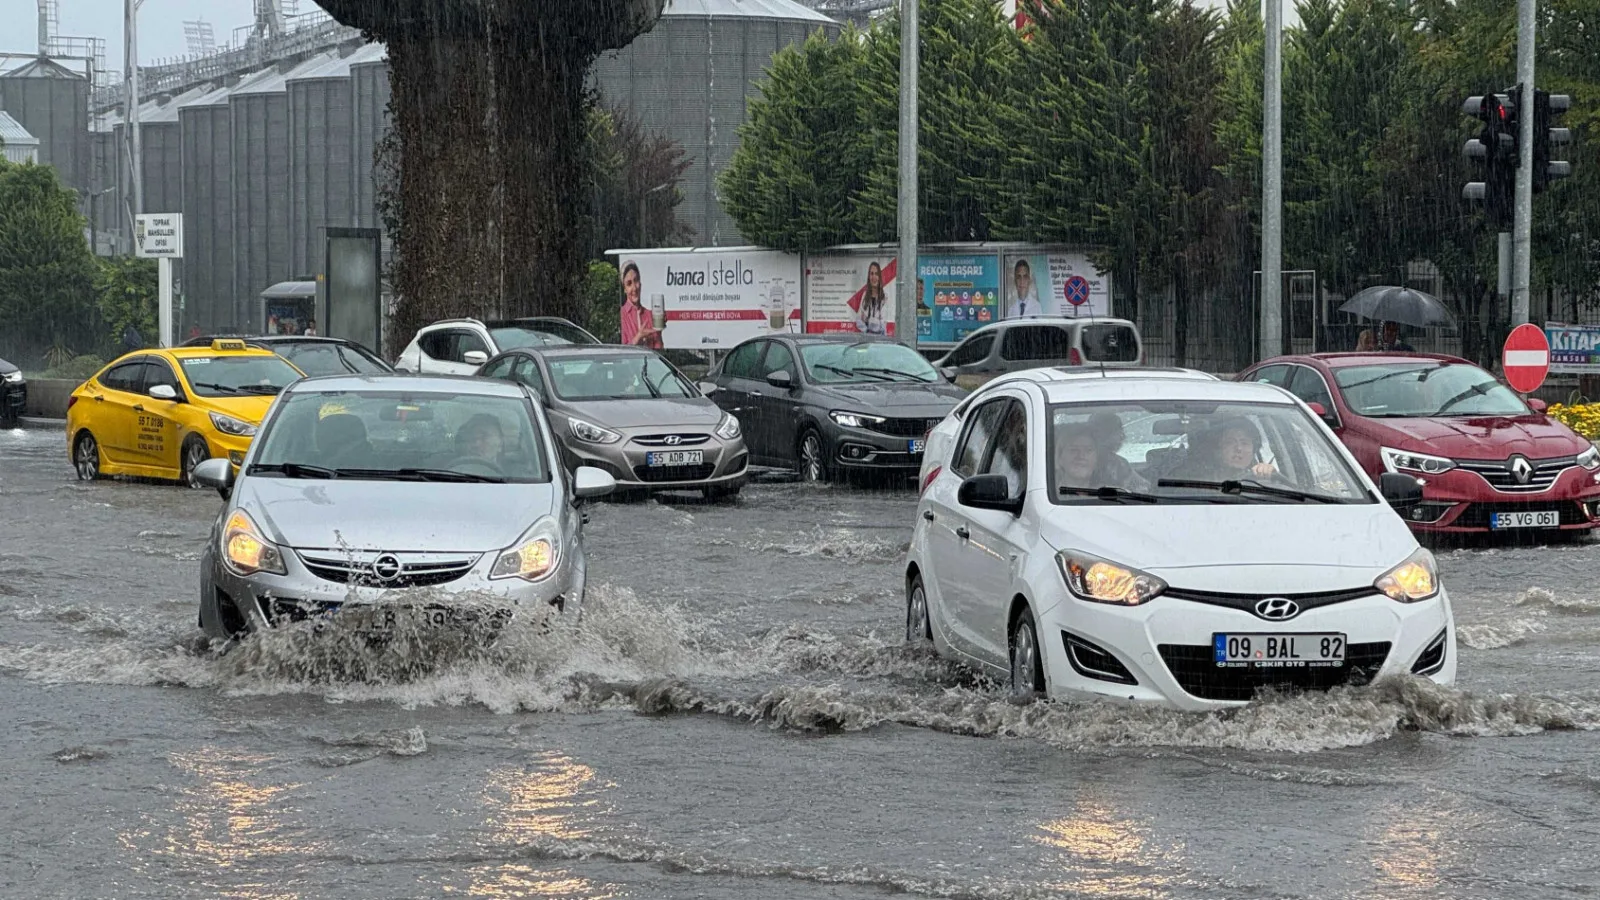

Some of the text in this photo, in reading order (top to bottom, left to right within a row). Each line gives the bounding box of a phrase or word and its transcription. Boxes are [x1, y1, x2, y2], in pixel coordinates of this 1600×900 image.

[667, 259, 753, 286] bianca stella
[920, 266, 984, 278] REKOR BAŞARI
[679, 294, 689, 302] yeni
[679, 311, 690, 319] HER
[702, 311, 714, 319] HER
[727, 311, 741, 319] BOYA
[1552, 331, 1600, 351] KİTAP
[139, 416, 145, 426] 55
[914, 441, 924, 451] 55
[653, 454, 664, 463] 55
[688, 452, 701, 462] 721
[1497, 512, 1555, 526] 55 VG 061
[1228, 637, 1252, 659] 09
[1266, 637, 1301, 659] BAL
[1320, 637, 1343, 659] 82
